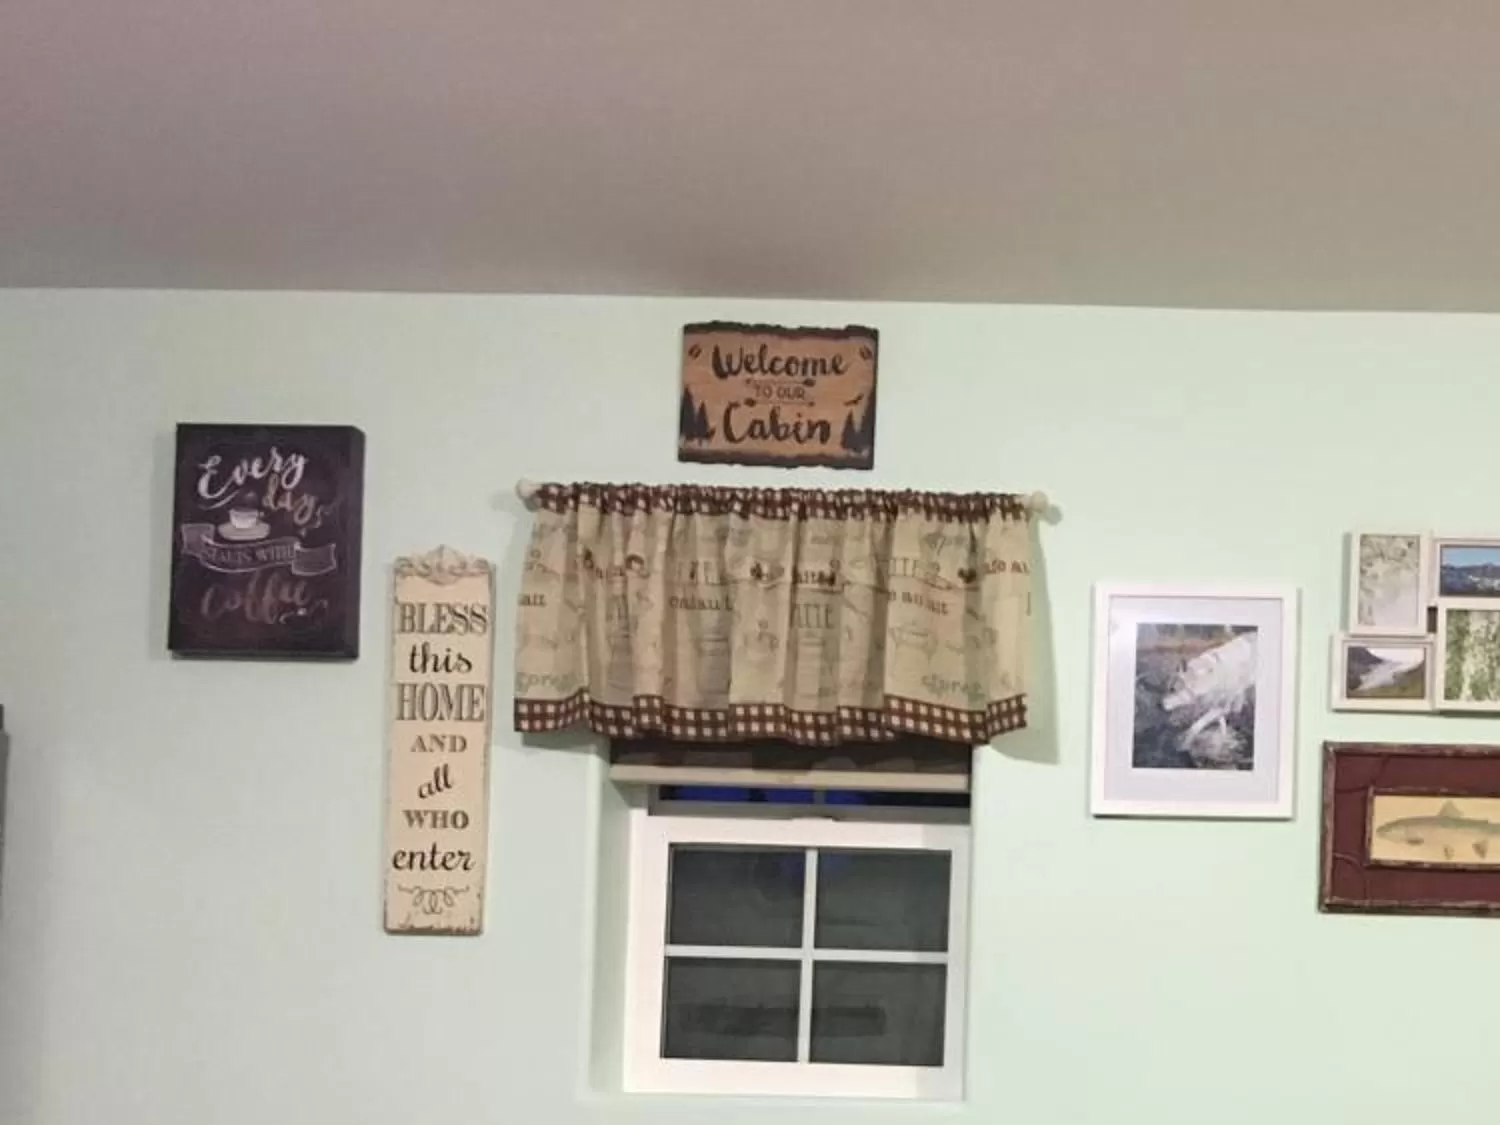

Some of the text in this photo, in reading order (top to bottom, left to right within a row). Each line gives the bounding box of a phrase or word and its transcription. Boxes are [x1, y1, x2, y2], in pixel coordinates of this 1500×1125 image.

[712, 344, 848, 379] Welcome
[754, 386, 805, 400] TO OUR
[723, 401, 831, 445] Cabin
[197, 446, 308, 499] Every
[262, 473, 318, 526] day
[397, 602, 488, 635] BLESS
[409, 642, 473, 674] this
[396, 682, 486, 722] HOME
[410, 735, 468, 752] AND
[418, 763, 454, 799] all
[402, 809, 470, 829] WHO
[392, 841, 476, 871] enter
